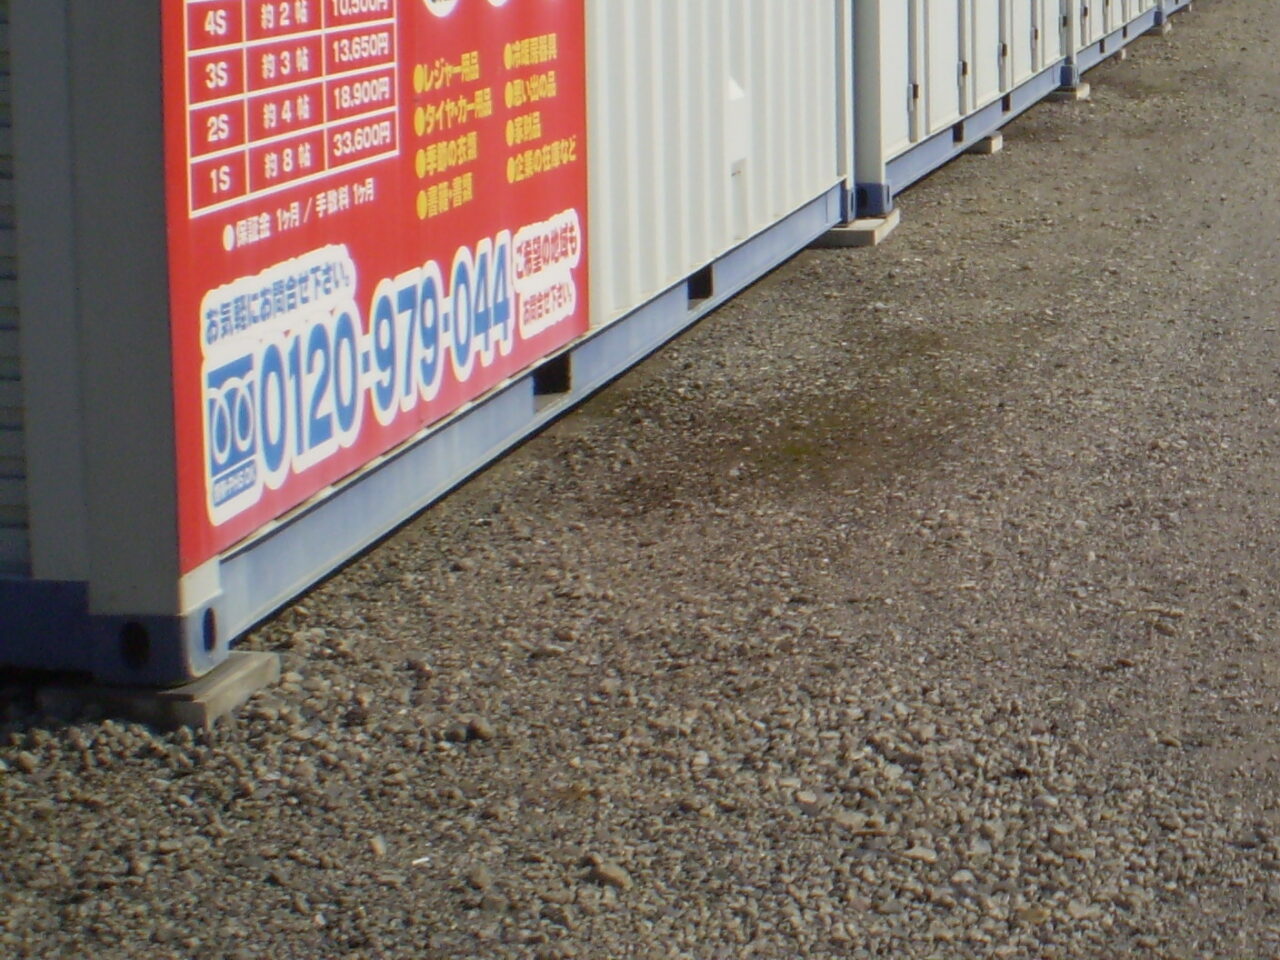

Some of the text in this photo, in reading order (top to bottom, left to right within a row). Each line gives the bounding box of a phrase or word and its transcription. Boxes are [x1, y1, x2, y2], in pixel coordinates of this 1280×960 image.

[204, 9, 227, 36] 4S
[205, 61, 229, 89] 3S
[424, 50, 480, 92] レジャー用品
[207, 114, 230, 142] 2S
[210, 165, 231, 194] 1S
[315, 184, 350, 218] 手数料
[260, 244, 510, 473] 0120-979-044
